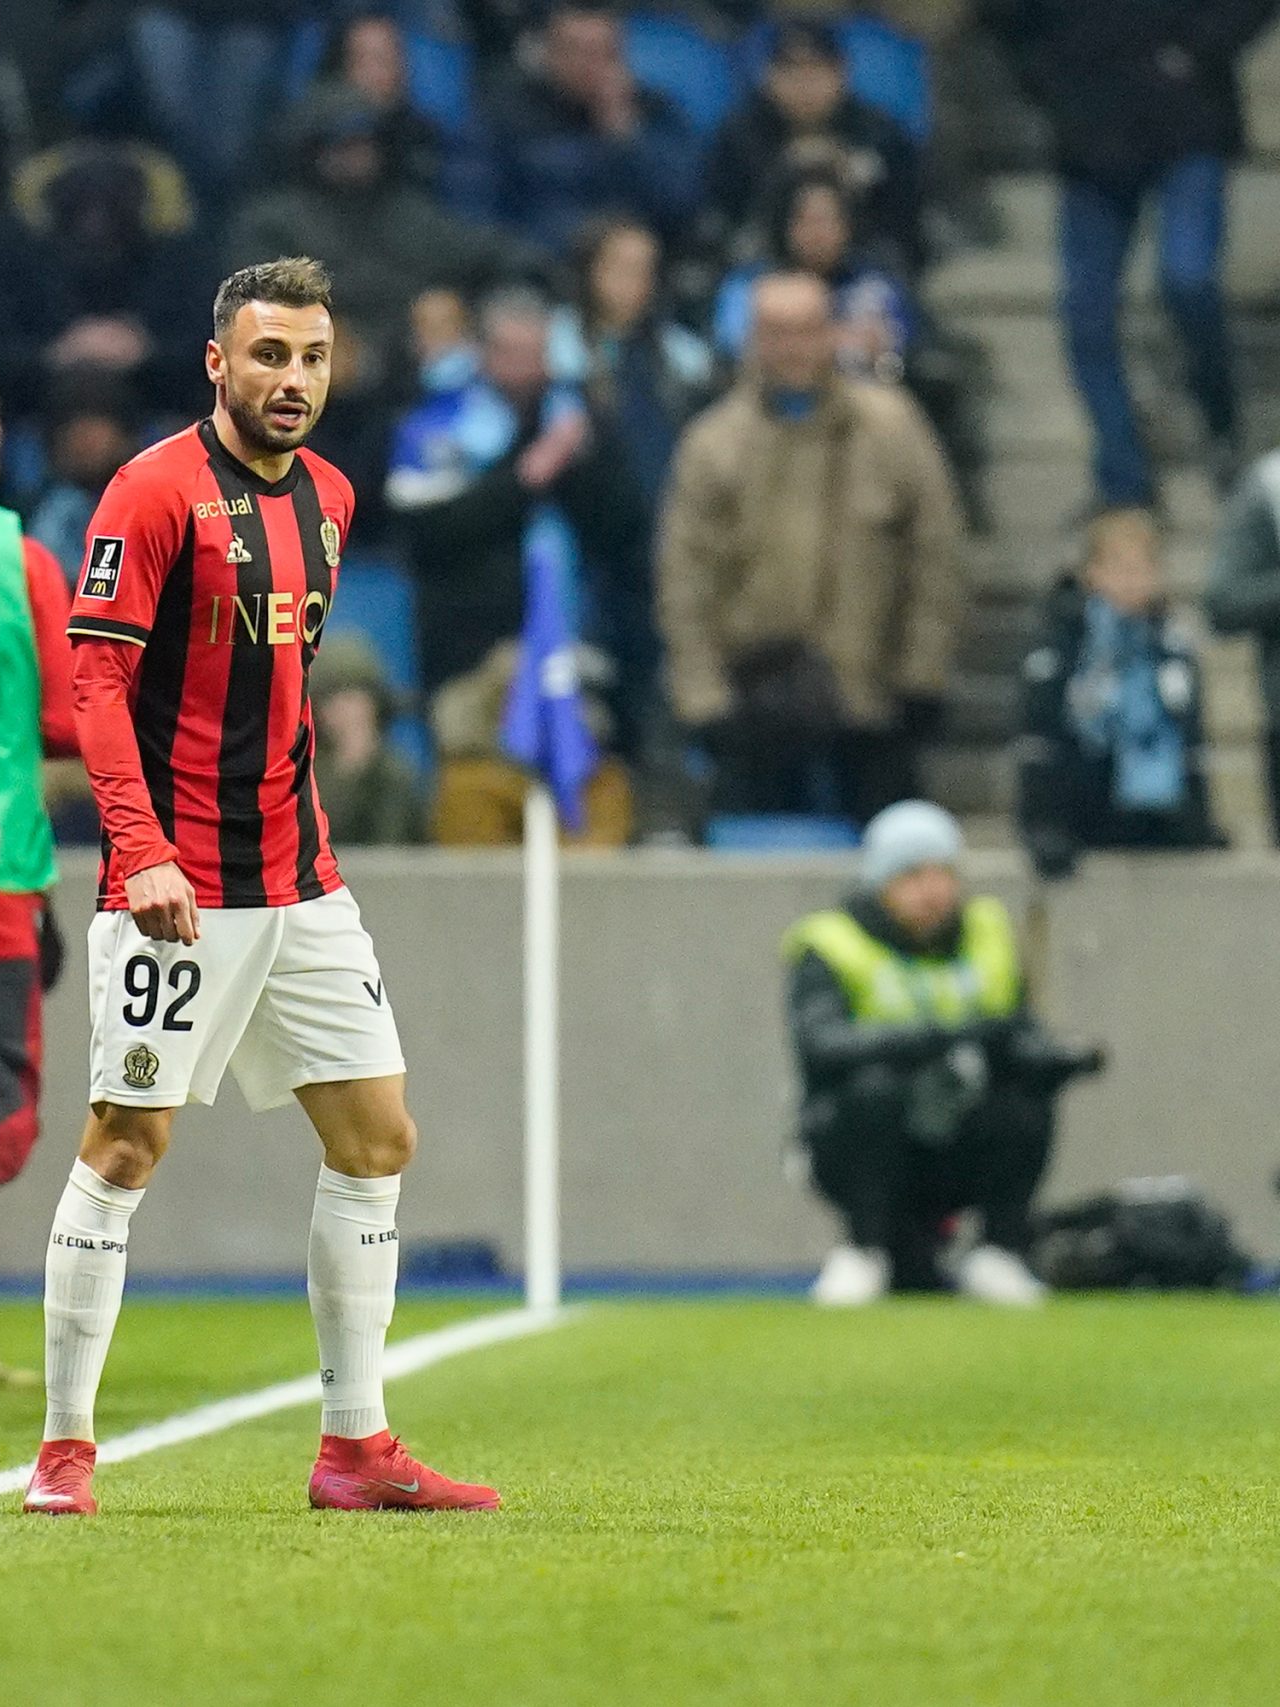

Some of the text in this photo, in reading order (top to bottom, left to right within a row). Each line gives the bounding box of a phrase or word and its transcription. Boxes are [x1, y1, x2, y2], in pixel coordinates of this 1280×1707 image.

[196, 493, 253, 518] actual
[207, 591, 333, 645] INEO
[122, 954, 201, 1032] 92
[53, 1233, 64, 1245] LE
[67, 1236, 95, 1250] COQ
[361, 1234, 375, 1245] LE
